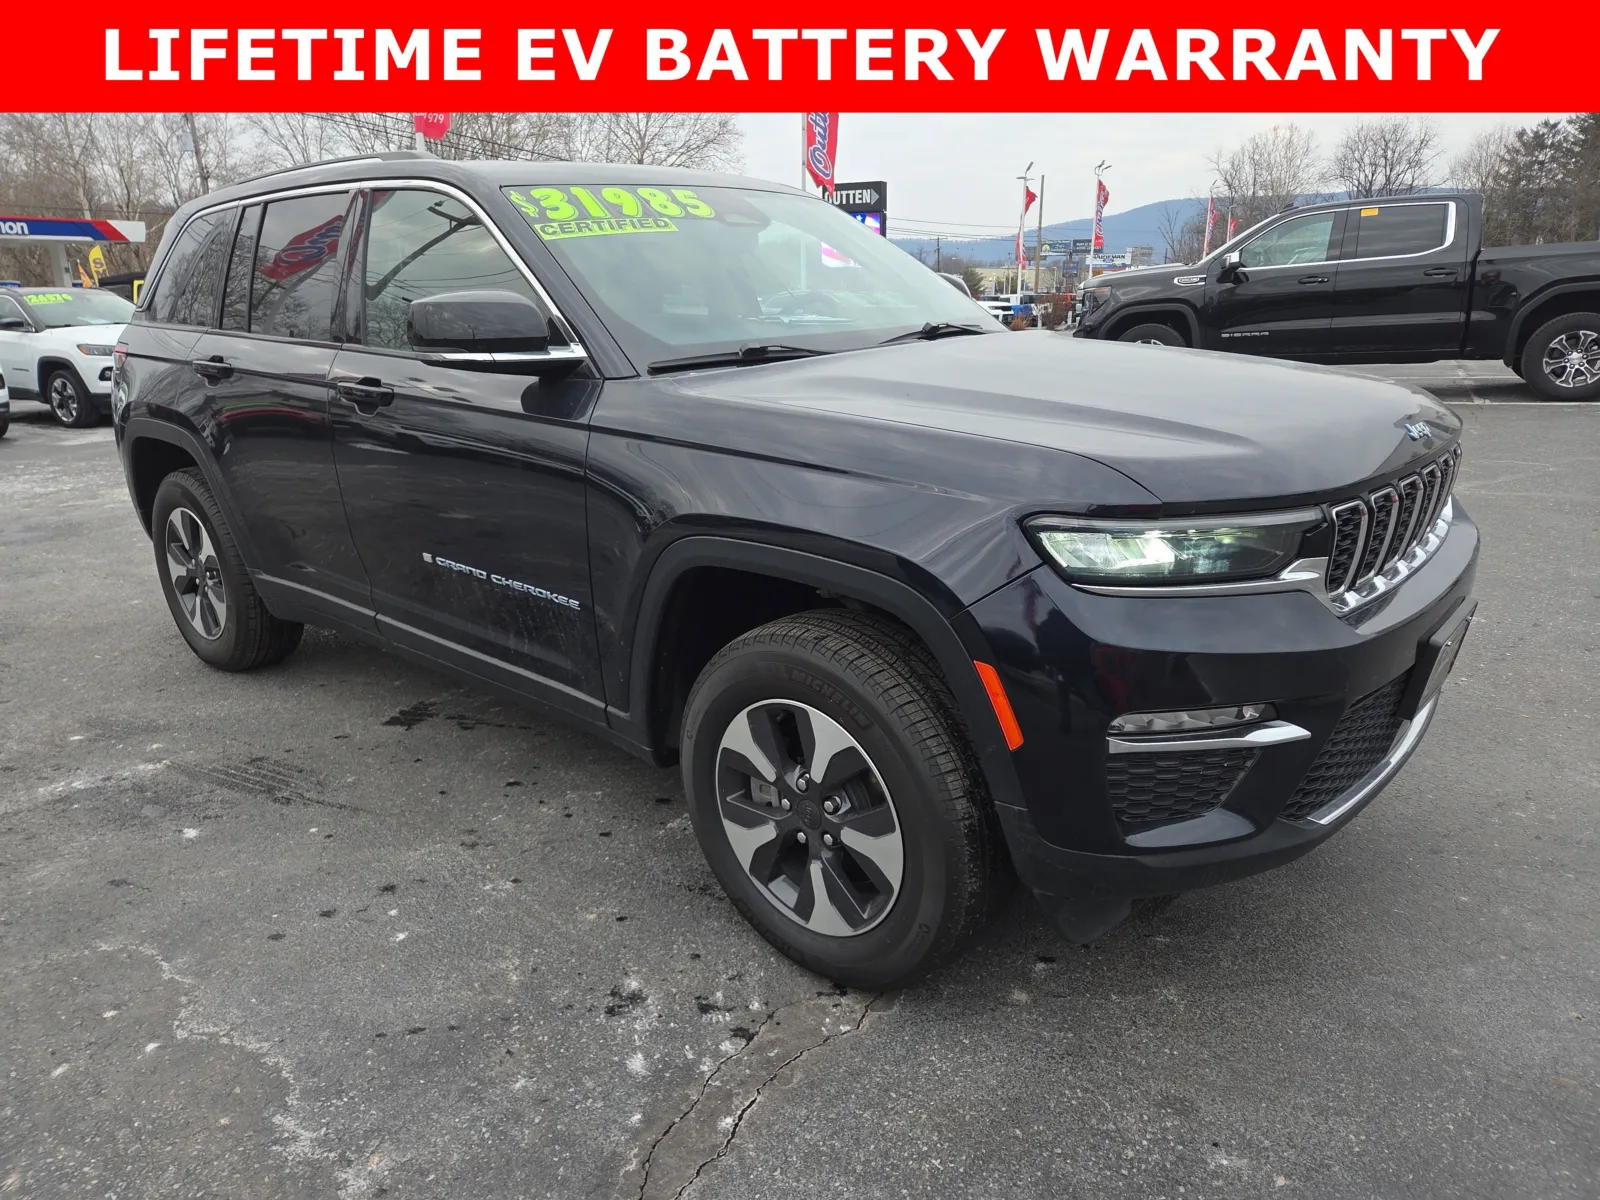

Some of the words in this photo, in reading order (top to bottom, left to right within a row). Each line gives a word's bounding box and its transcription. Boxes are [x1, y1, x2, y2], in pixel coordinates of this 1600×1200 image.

[509, 186, 716, 221] $31985
[539, 217, 673, 237] CERTIFIED
[1403, 422, 1432, 440] Jeep
[435, 556, 488, 580] GRAND
[490, 573, 581, 611] CHEROKEE
